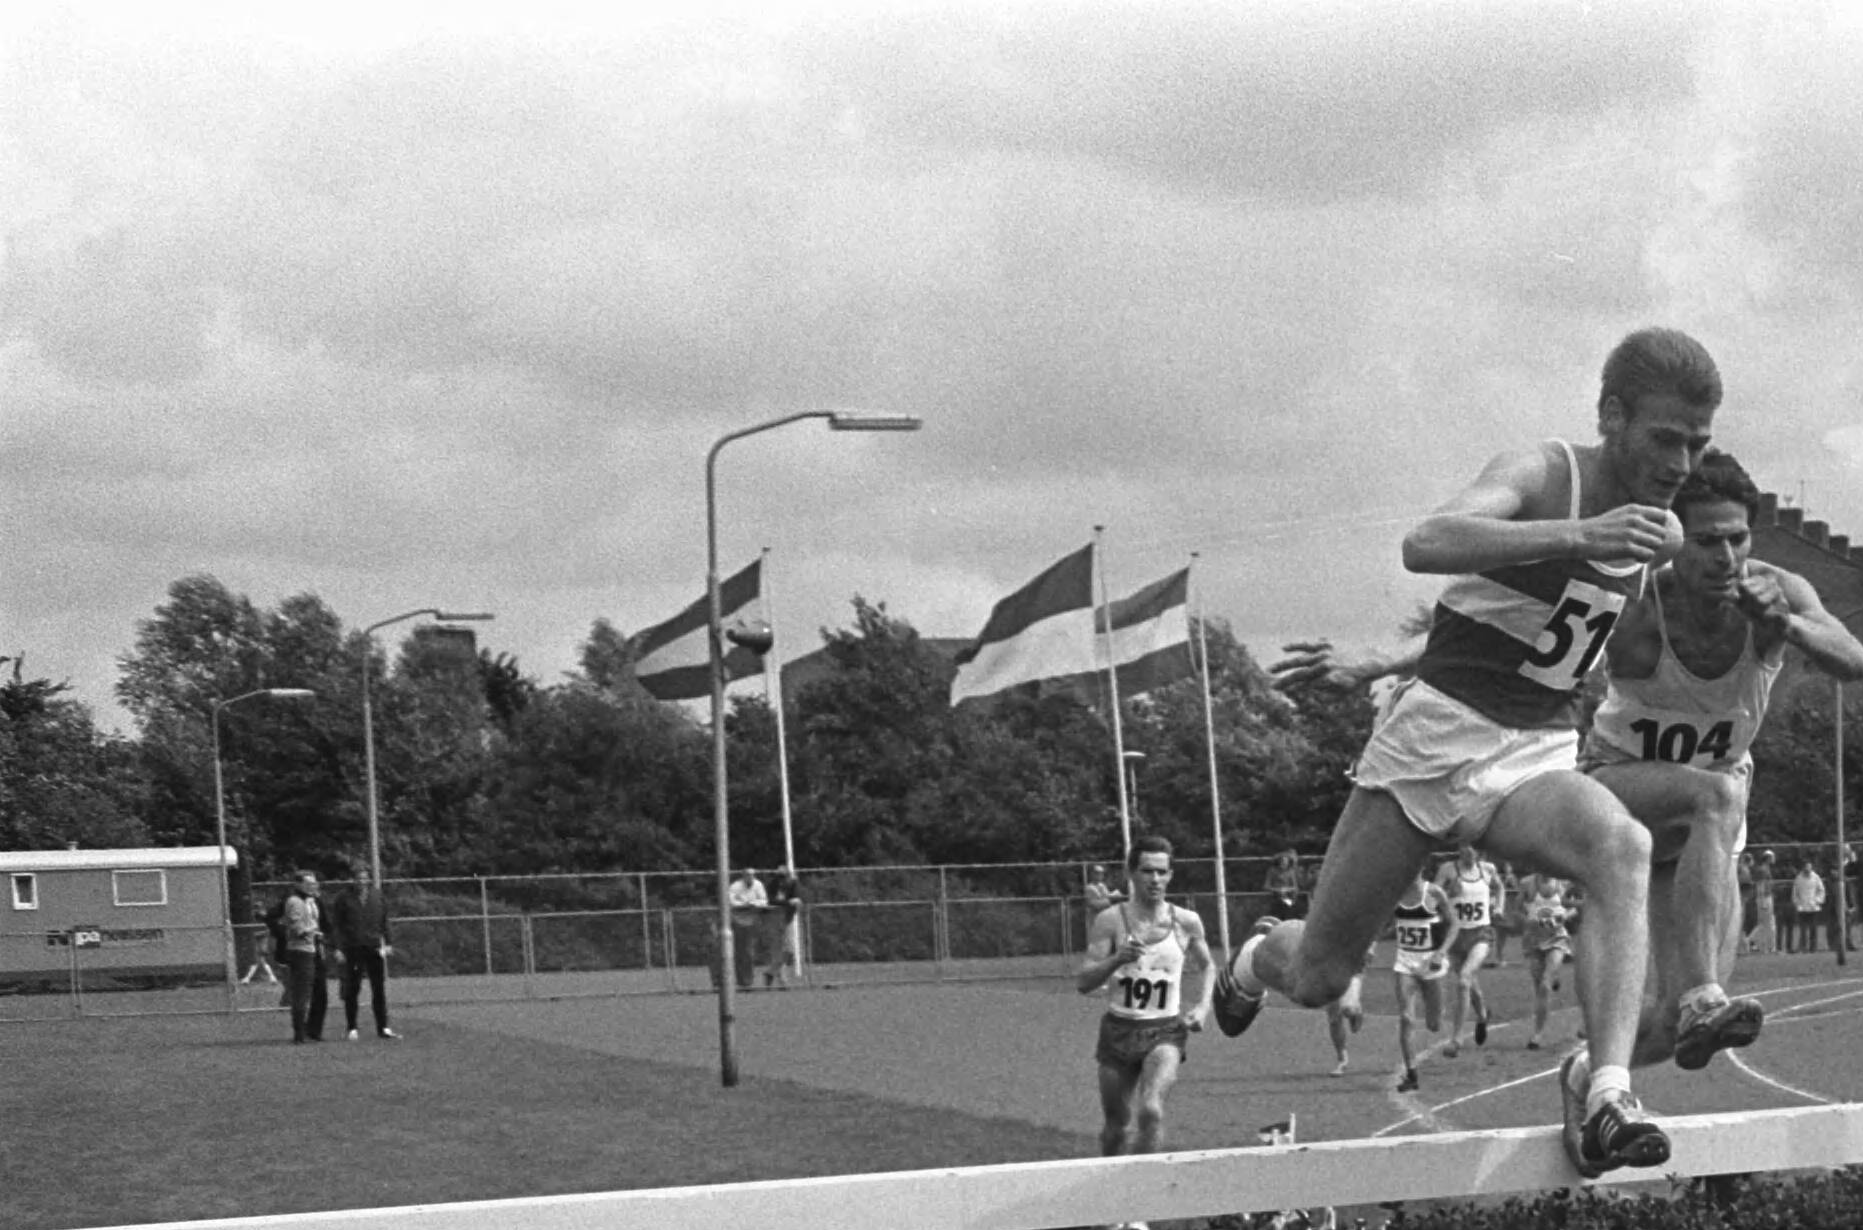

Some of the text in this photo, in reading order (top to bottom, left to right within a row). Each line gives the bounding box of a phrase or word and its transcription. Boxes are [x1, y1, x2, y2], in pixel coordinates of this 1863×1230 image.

[1518, 597, 1619, 679] 51
[1630, 718, 1734, 764] 104
[1454, 902, 1485, 922] 195
[1118, 977, 1168, 1010] 191
